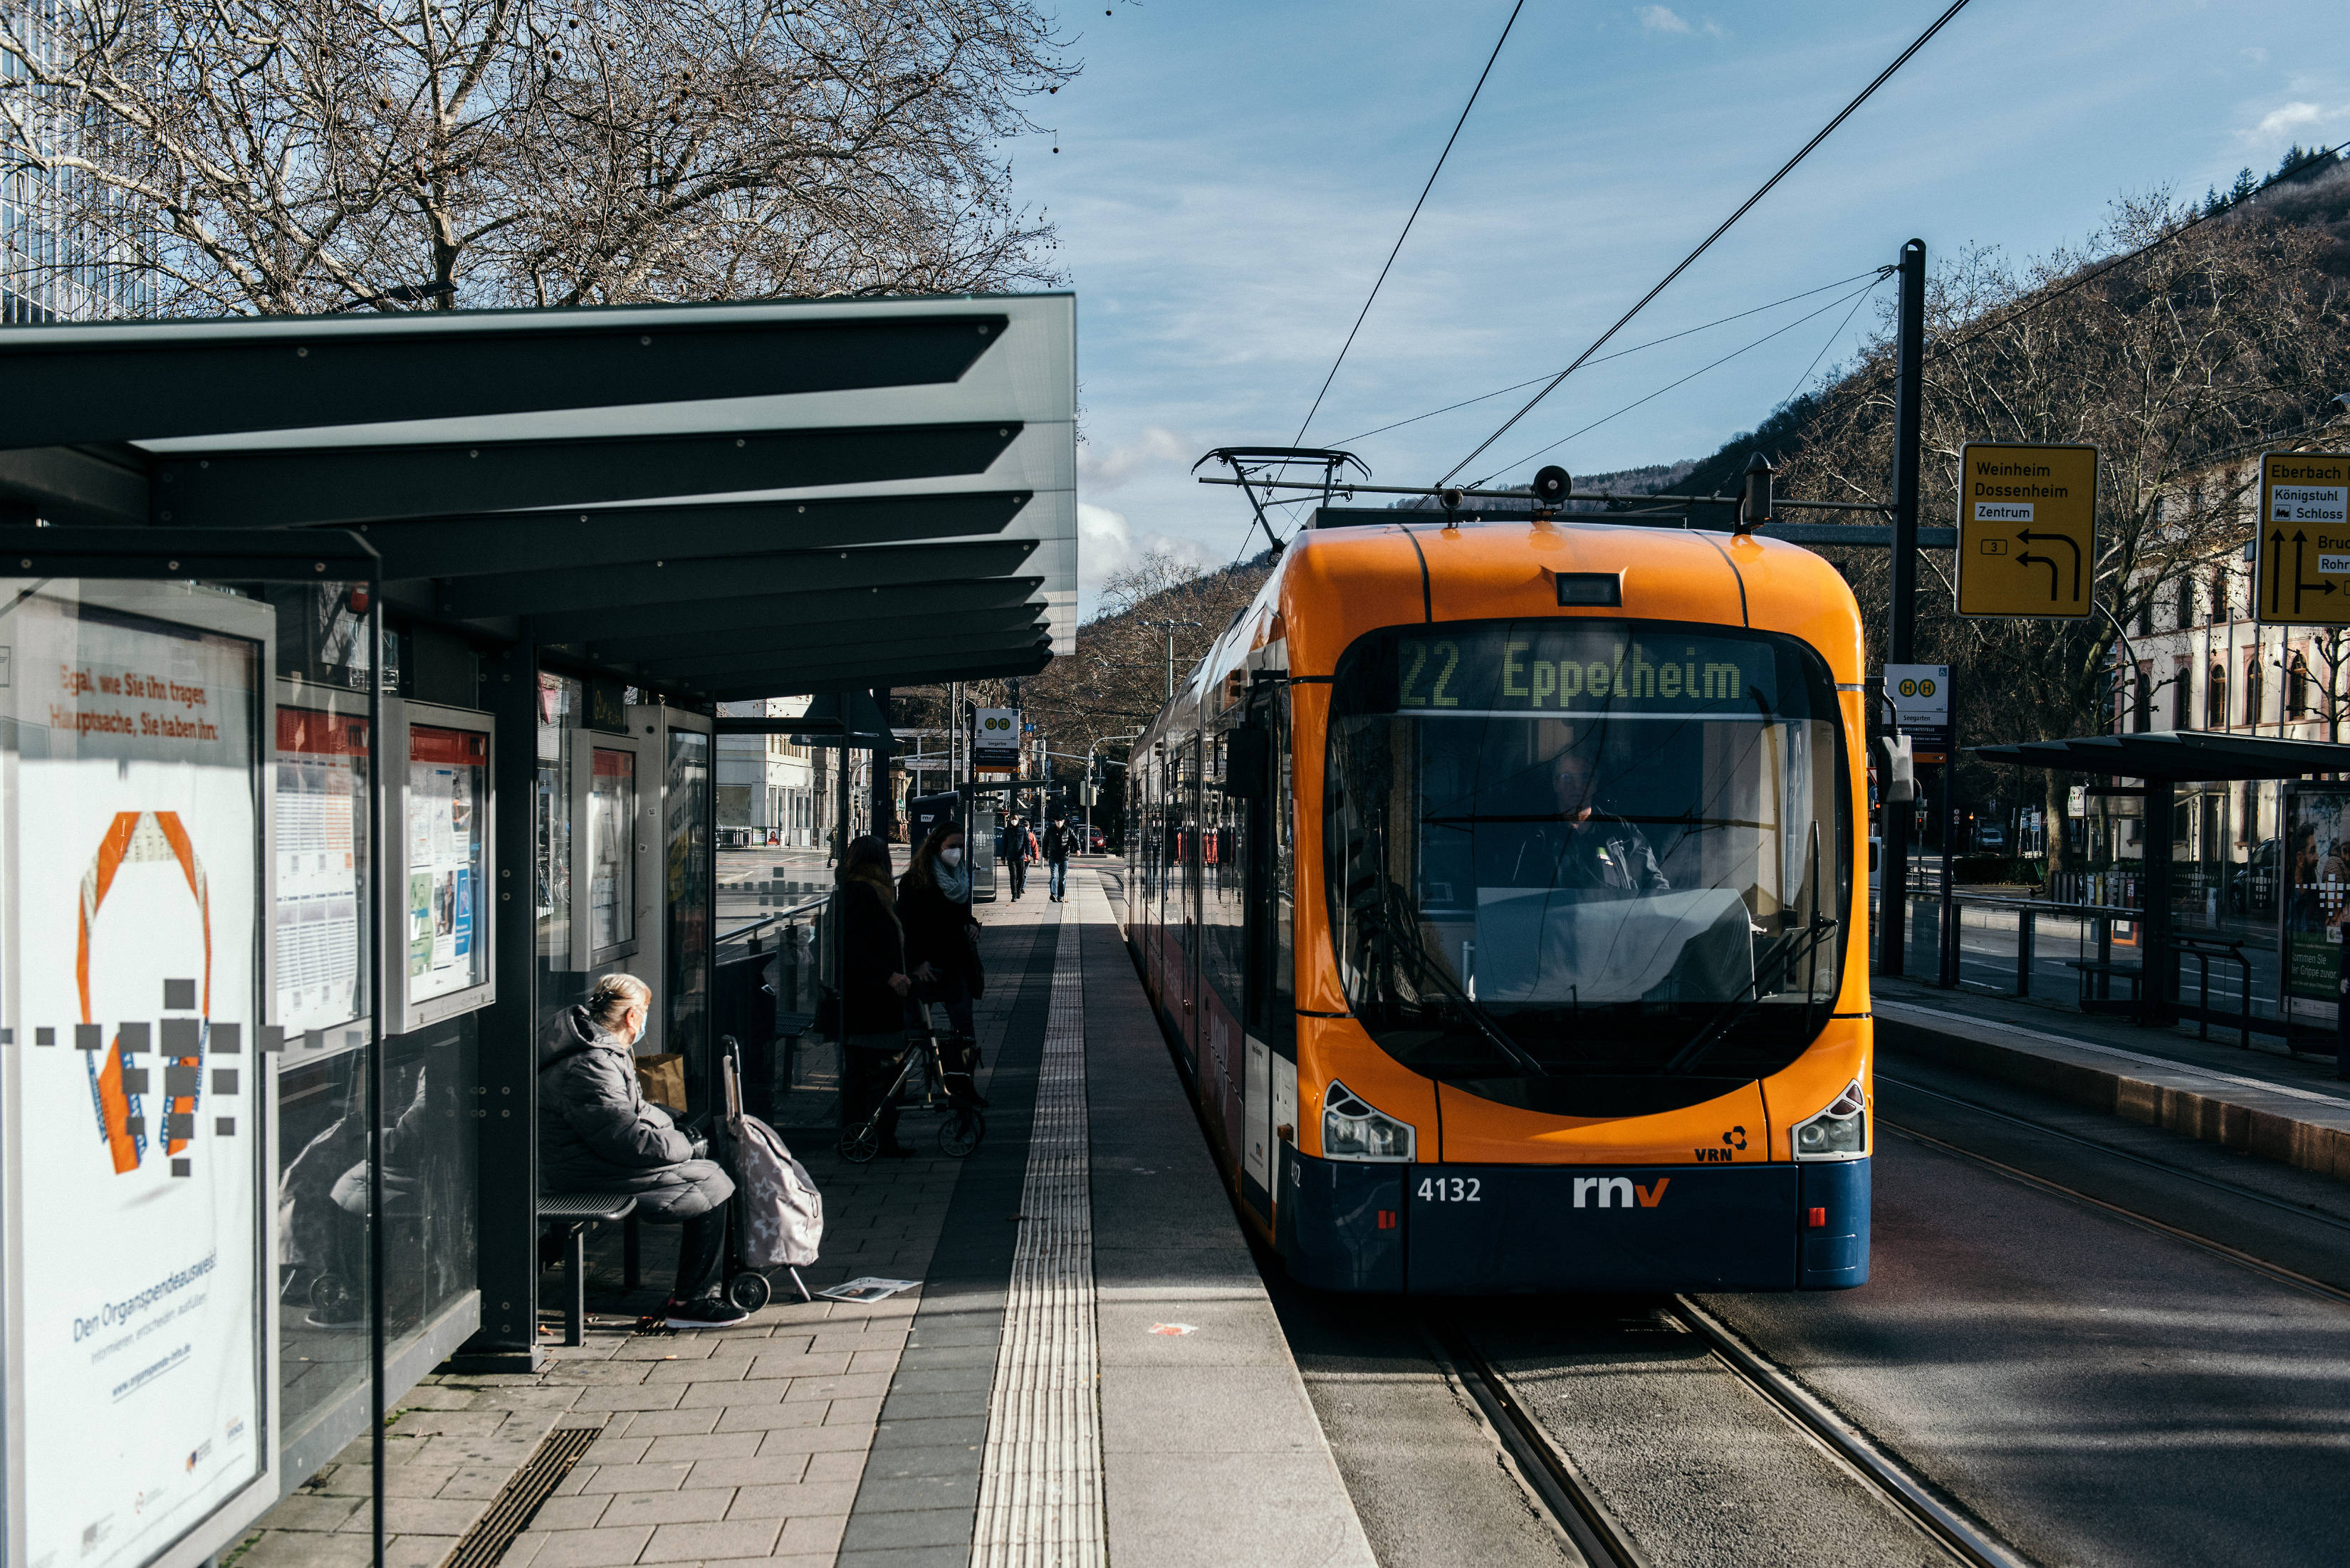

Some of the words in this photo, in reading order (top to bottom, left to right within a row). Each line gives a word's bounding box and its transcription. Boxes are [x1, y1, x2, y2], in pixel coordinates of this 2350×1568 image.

[1976, 461, 2050, 477] Weinheim
[2272, 464, 2341, 479] Eberbach
[1975, 482, 2068, 498] Dossenheim
[2275, 488, 2339, 503] Königstuhl
[1978, 506, 2030, 518] Zentrum
[2296, 507, 2343, 519] Schloss
[1990, 542, 1998, 553] 3
[1400, 641, 1458, 706] 22
[1503, 641, 1740, 707] Eppelheim
[60, 664, 95, 696] Egal,
[98, 674, 121, 695] wie
[124, 672, 145, 697] Sie
[147, 674, 167, 700] ihn
[169, 679, 207, 709] tragen,
[140, 711, 159, 736] Sie
[160, 714, 197, 738] haben
[2317, 953, 2326, 965] Sie
[2300, 965, 2319, 979] Grippe
[2319, 969, 2338, 980] zuvor.
[1694, 1148, 1733, 1161] VRN
[1418, 1178, 1481, 1202] 4132
[1572, 1176, 1671, 1208] rnv
[74, 1315, 99, 1342] Den
